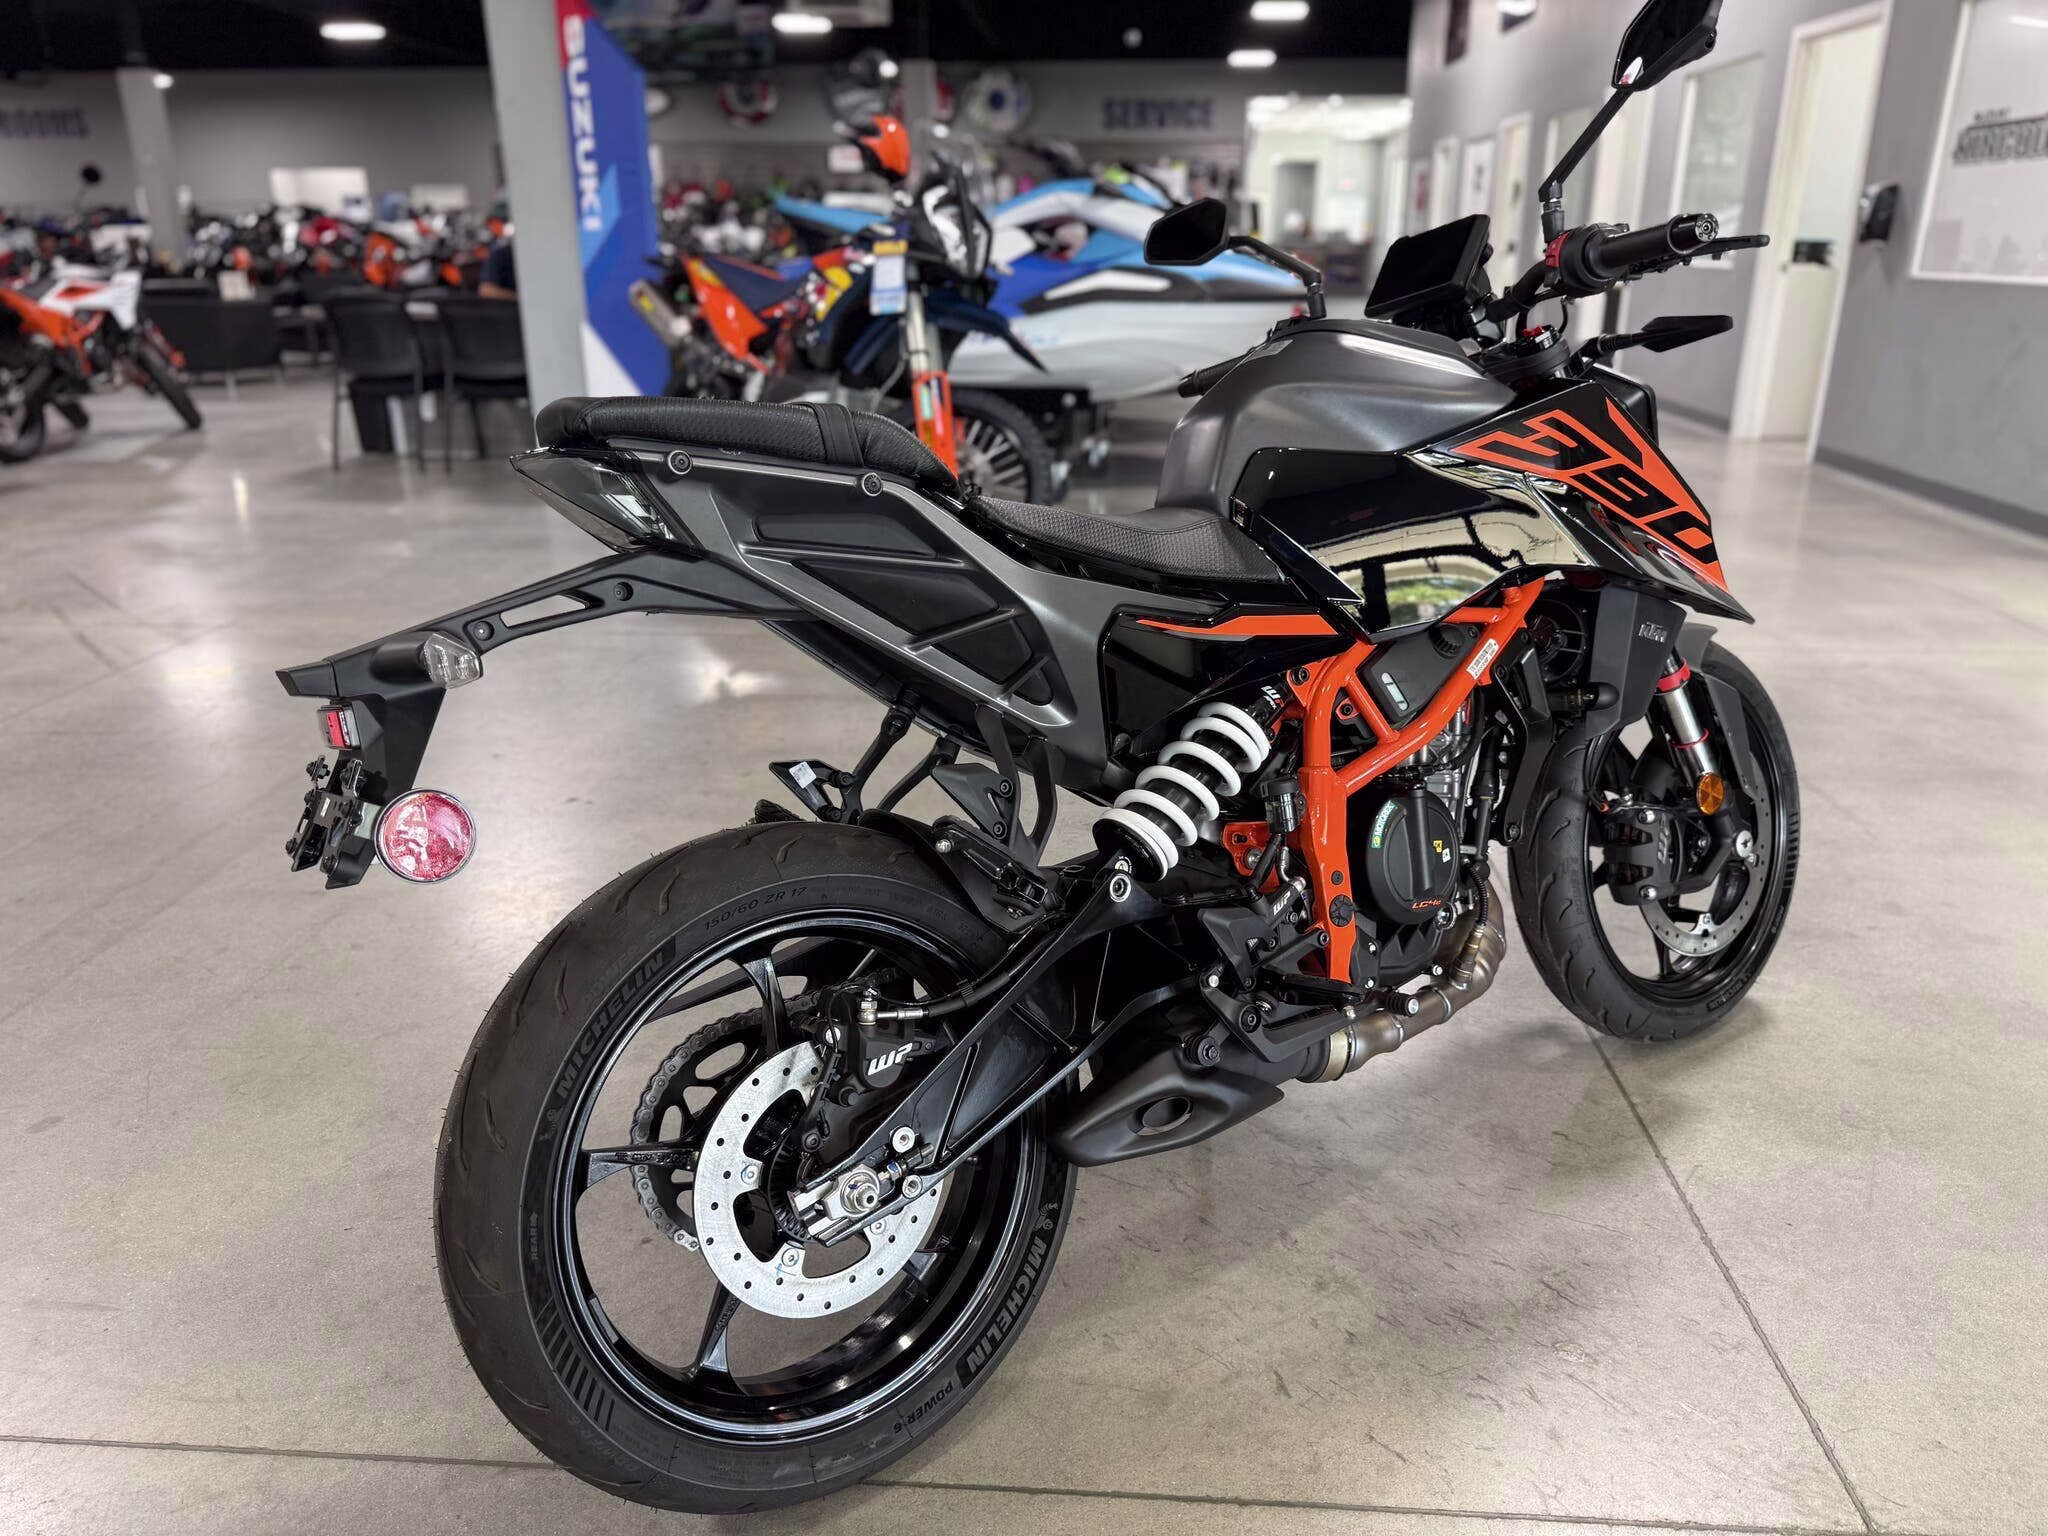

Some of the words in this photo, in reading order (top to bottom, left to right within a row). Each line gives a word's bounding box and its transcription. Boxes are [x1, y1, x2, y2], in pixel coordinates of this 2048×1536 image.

[562, 13, 603, 232] SUZUKI
[1103, 97, 1214, 132] SERVICE
[1638, 621, 1668, 643] KTM
[555, 949, 665, 1099] MICHELIN
[867, 1042, 913, 1076] WP
[965, 1235, 1049, 1374] MICHELIN
[906, 1383, 954, 1425] POWER
